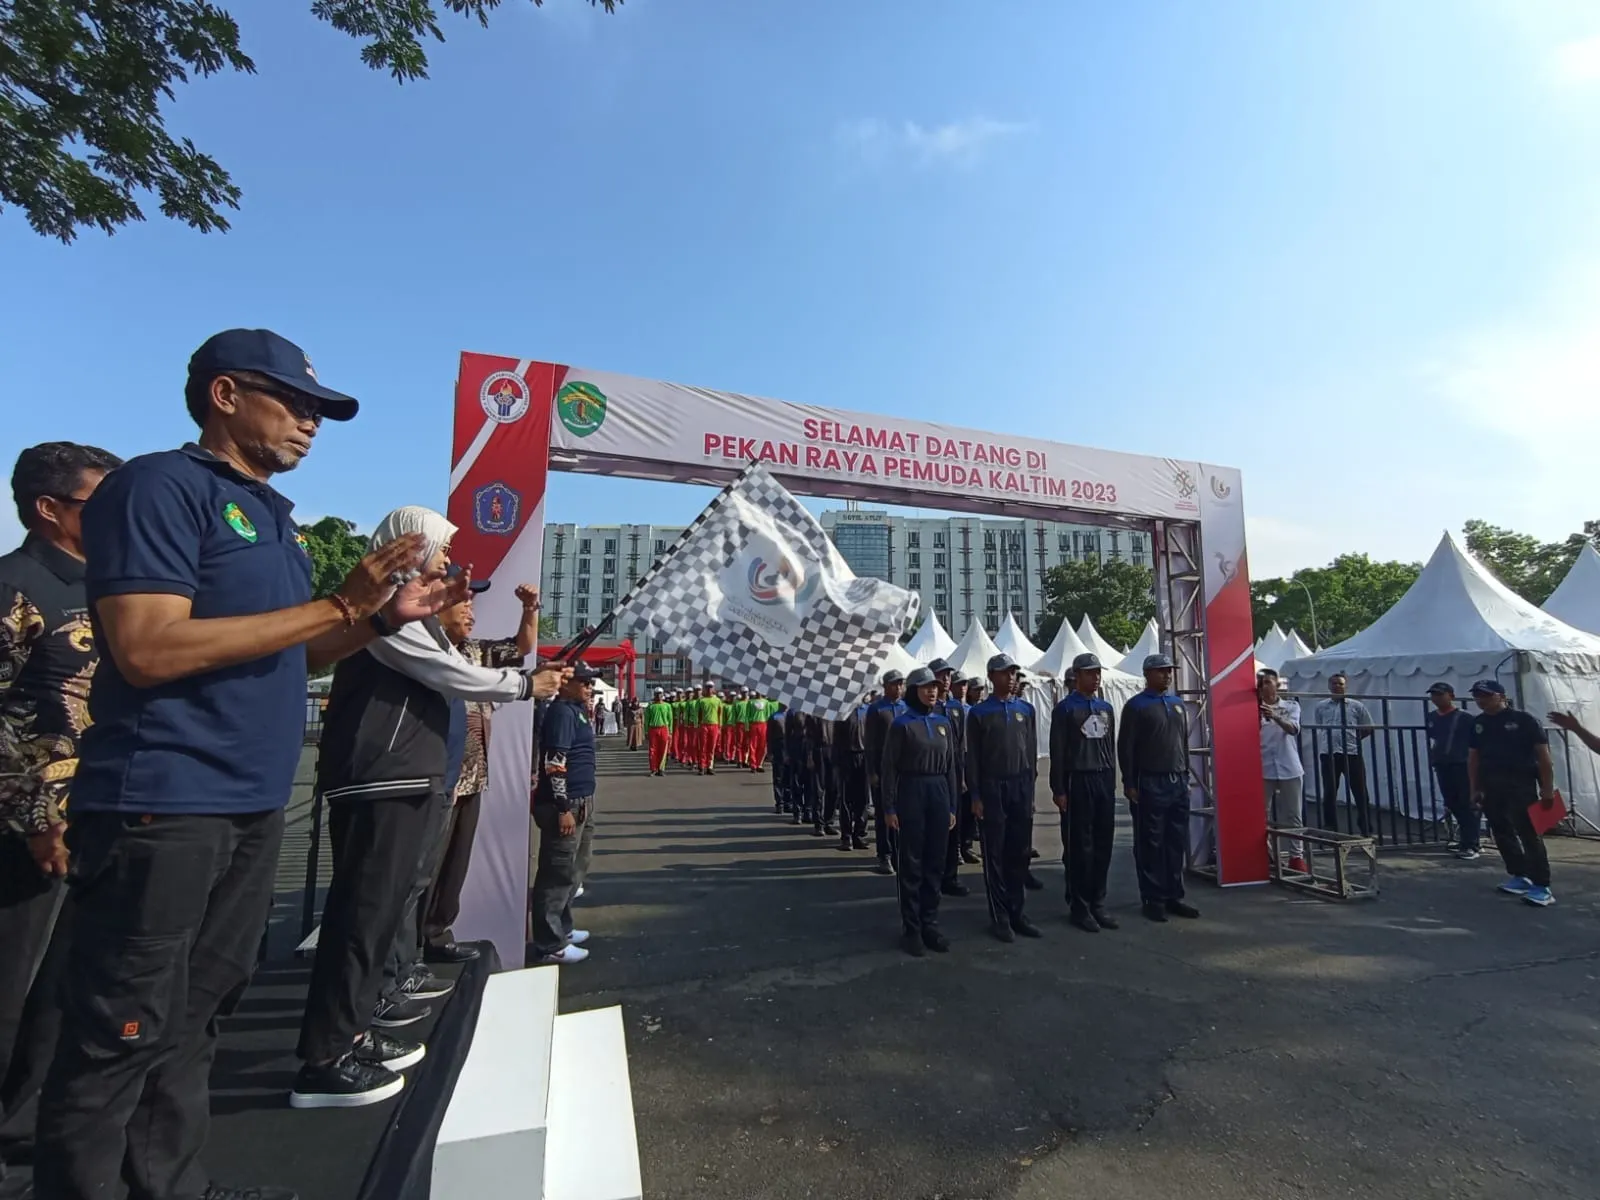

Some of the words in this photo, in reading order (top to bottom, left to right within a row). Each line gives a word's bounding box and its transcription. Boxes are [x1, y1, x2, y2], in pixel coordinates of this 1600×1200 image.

[704, 433, 798, 465] PEKAN
[806, 446, 877, 475] RAYA
[884, 456, 983, 487] PEMUDA
[989, 470, 1066, 497] KALTIM
[1071, 480, 1117, 503] 2023
[803, 418, 919, 453] SELAMAT
[926, 436, 1021, 467] DATANG
[1026, 450, 1047, 471] DI
[1092, 721, 1098, 732] 1
